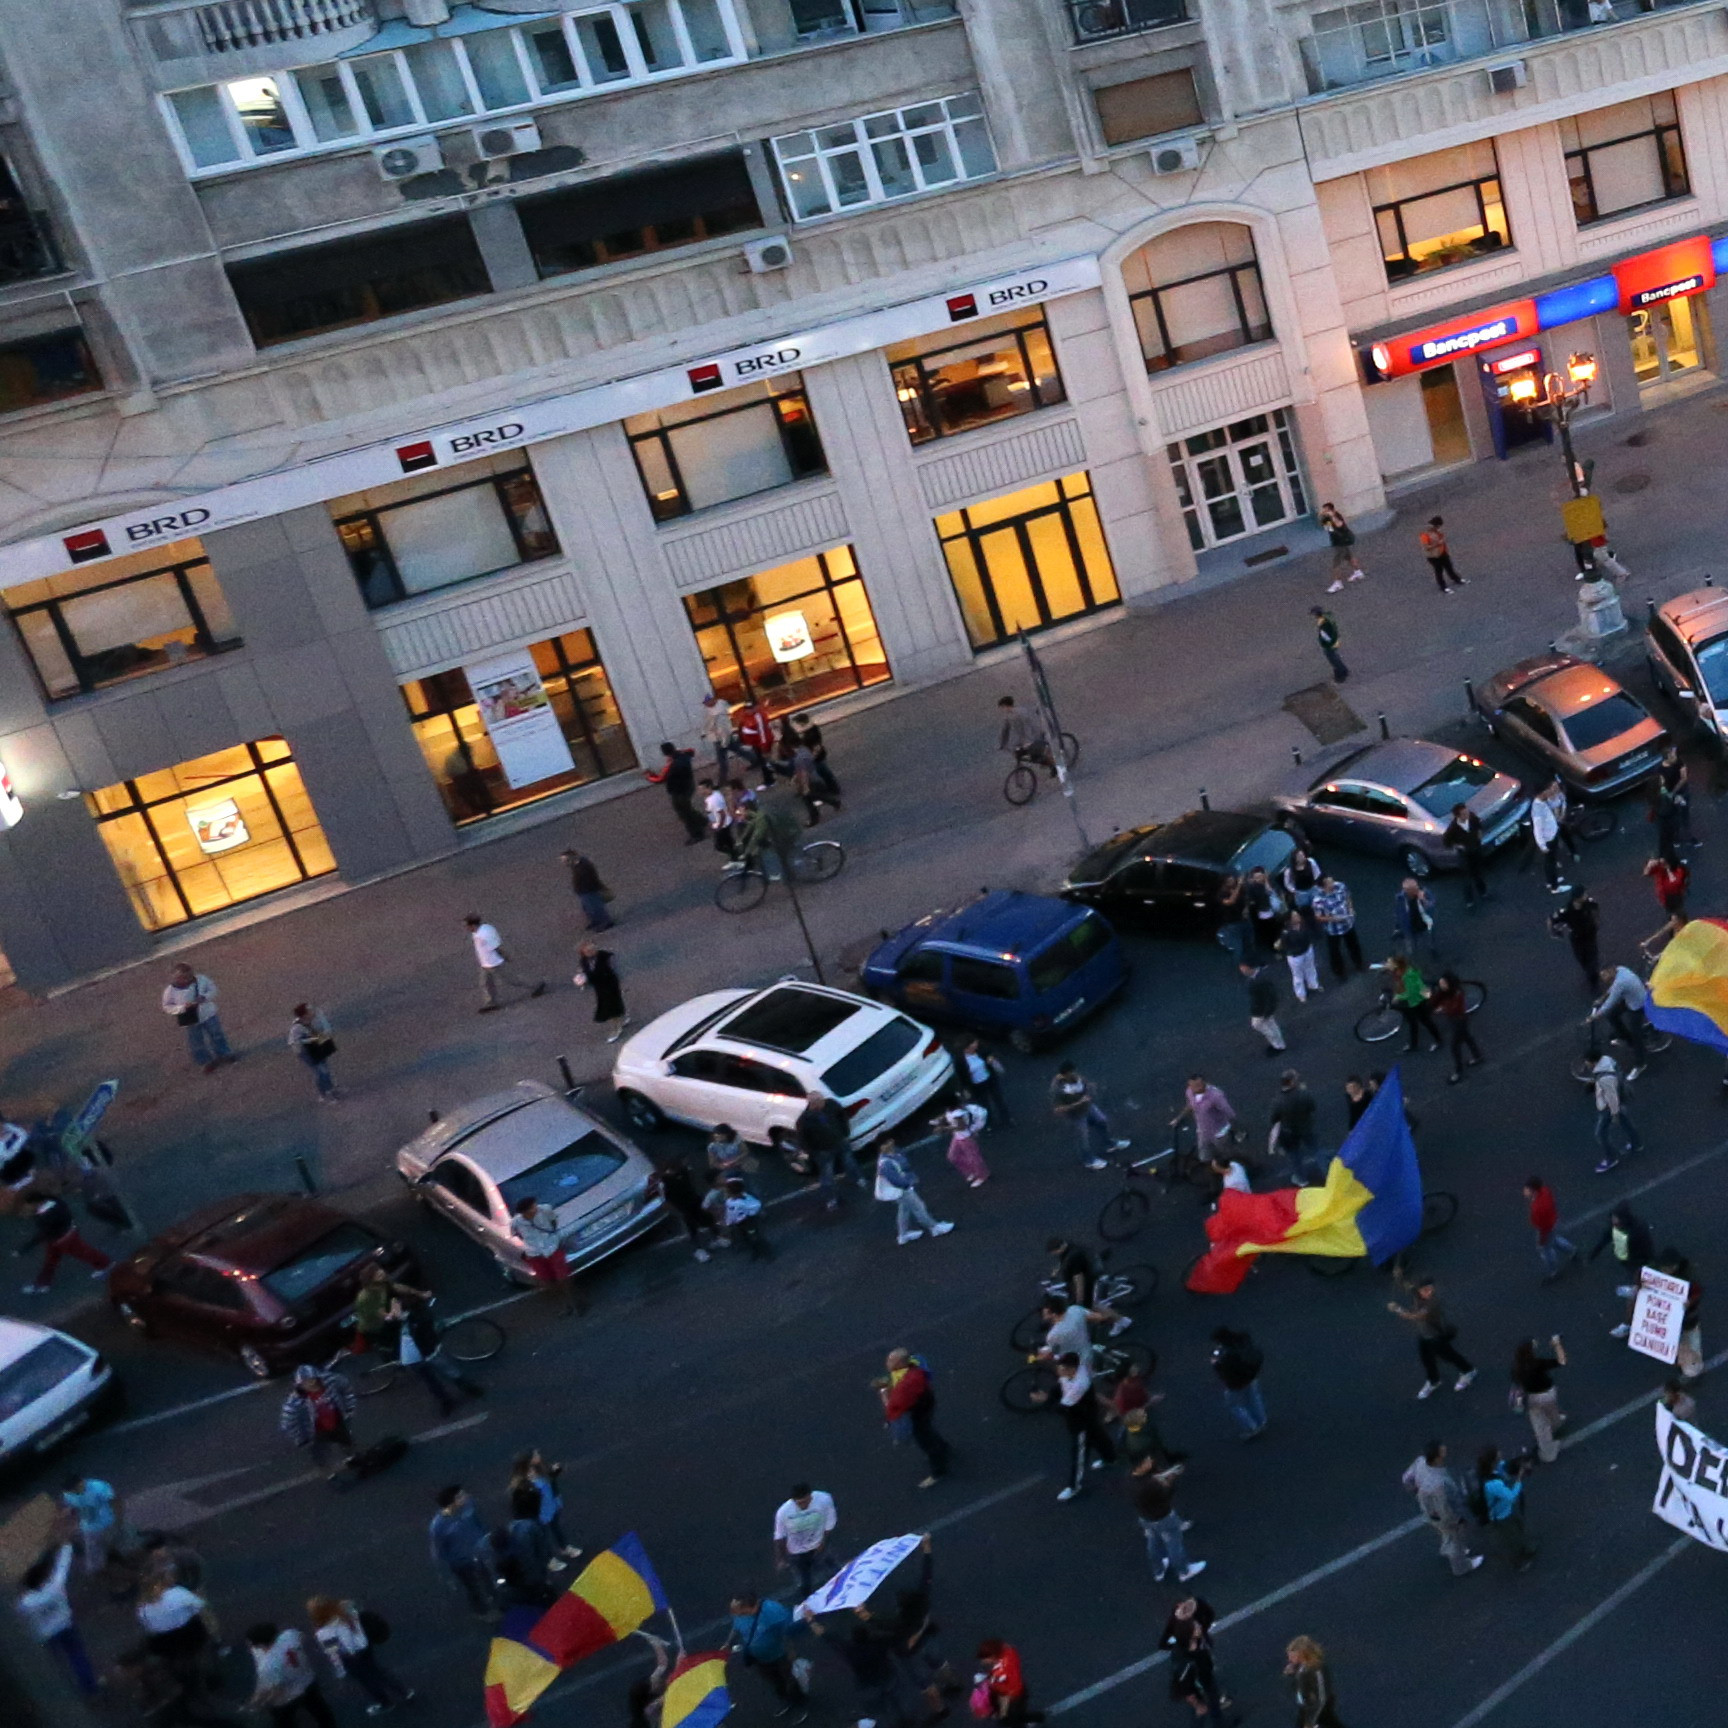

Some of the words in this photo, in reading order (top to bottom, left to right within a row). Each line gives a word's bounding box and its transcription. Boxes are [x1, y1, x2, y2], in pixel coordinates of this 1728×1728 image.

[989, 279, 1049, 306] BRD
[1640, 277, 1698, 305] Bancpost
[1422, 321, 1507, 361] Bancpost
[735, 347, 801, 376] BRD
[449, 422, 525, 453] BRD
[126, 507, 211, 542] BRD
